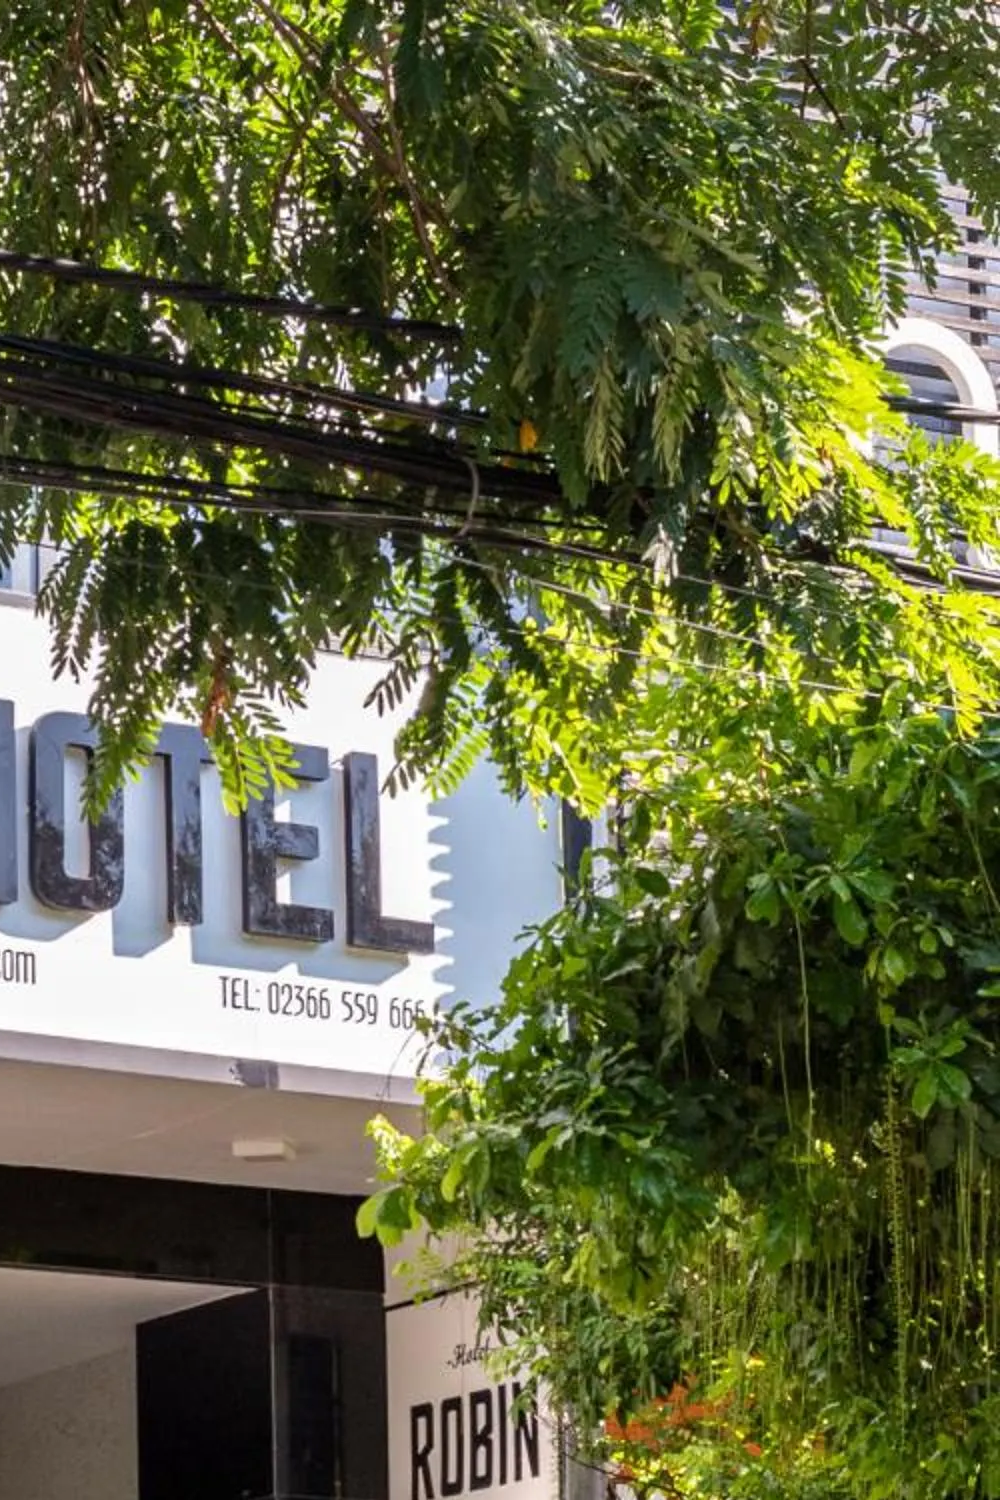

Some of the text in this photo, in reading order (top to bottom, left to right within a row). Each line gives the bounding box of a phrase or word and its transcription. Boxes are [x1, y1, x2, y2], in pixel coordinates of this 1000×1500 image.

[218, 975, 260, 1011] TEL:
[267, 981, 330, 1019] 02366
[341, 991, 378, 1025] 559
